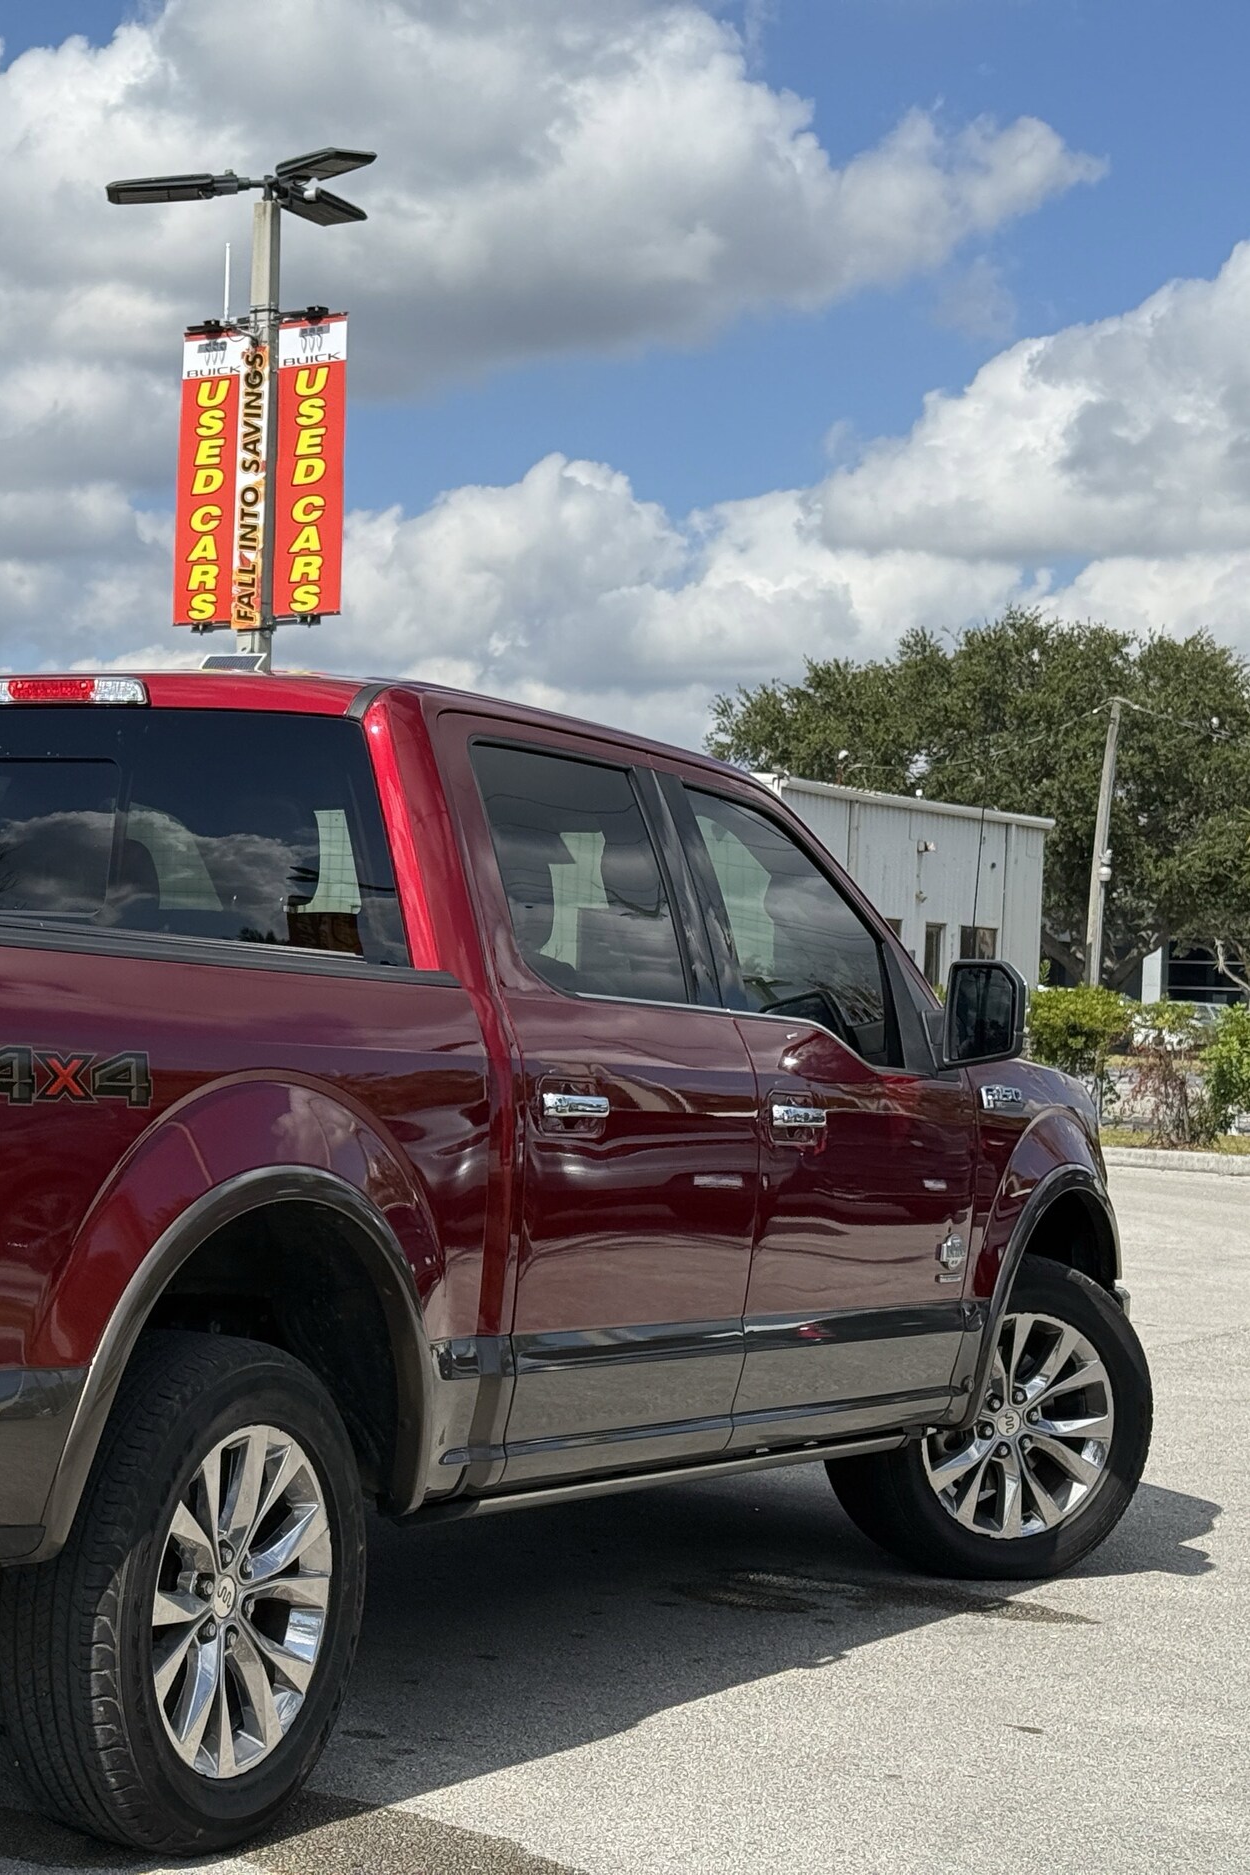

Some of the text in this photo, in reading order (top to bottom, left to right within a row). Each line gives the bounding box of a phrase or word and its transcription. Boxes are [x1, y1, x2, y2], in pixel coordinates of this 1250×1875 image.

[187, 365, 241, 378] BUICK
[283, 352, 341, 367] BUICK
[186, 379, 231, 622] USED CARS
[236, 352, 264, 622] FALL INTO SAVINGS
[288, 366, 330, 613] USED CARS
